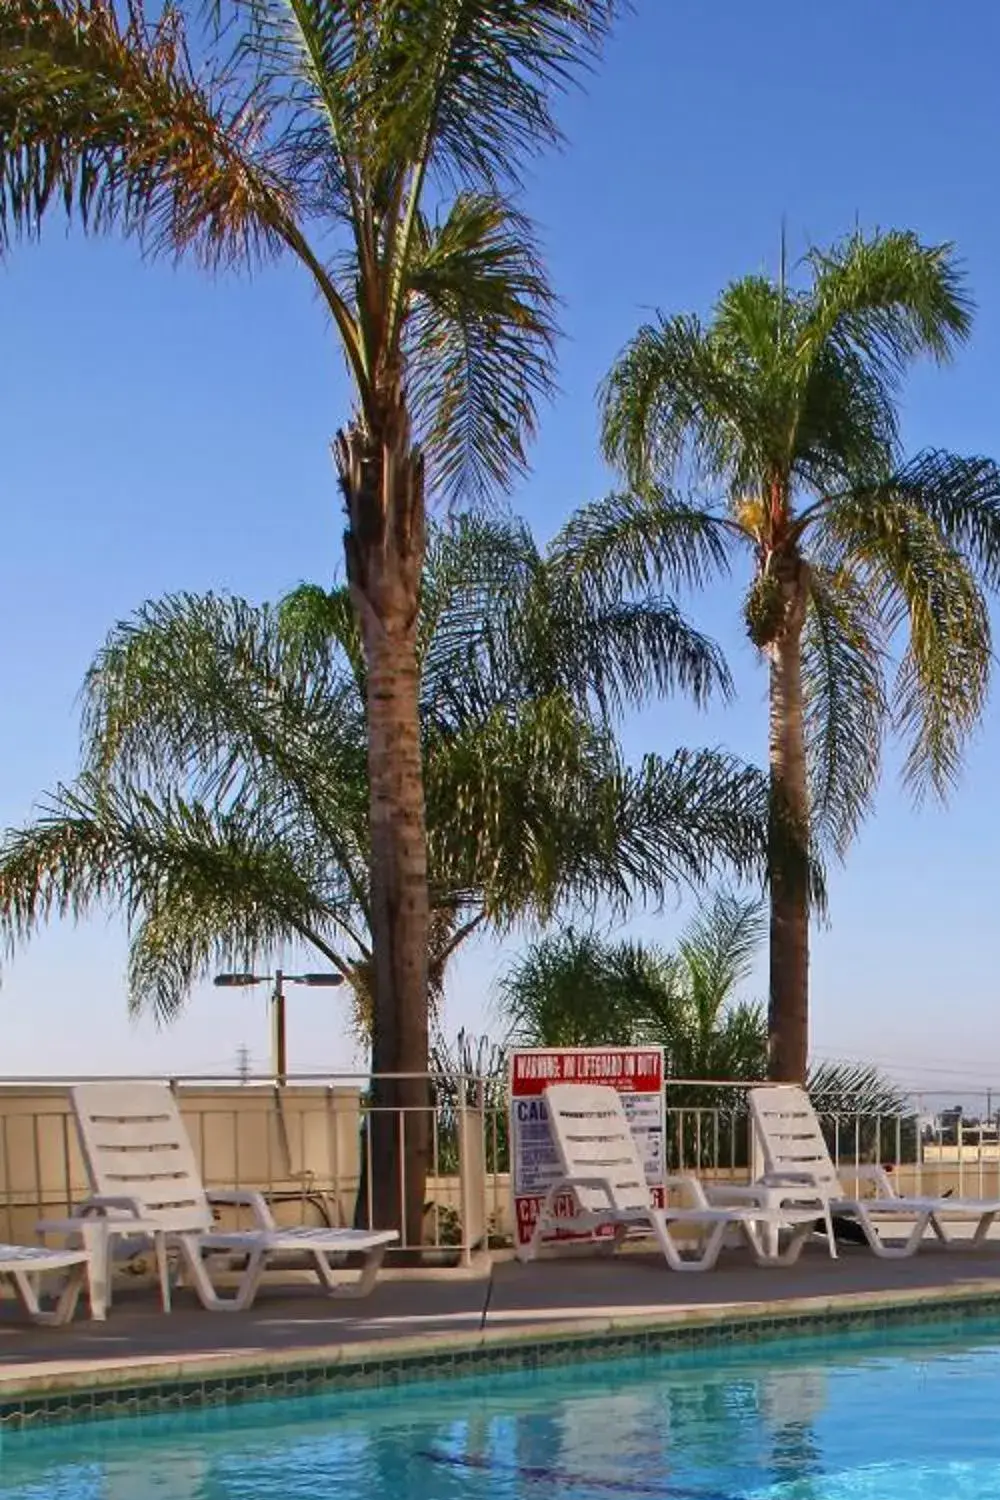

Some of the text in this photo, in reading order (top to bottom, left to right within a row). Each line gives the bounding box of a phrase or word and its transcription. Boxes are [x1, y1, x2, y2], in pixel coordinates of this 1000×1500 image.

[577, 1055, 621, 1078] LIFEGUARD
[623, 1055, 635, 1077] ON
[637, 1054, 658, 1077] DUTY
[518, 1102, 548, 1121] CAU
